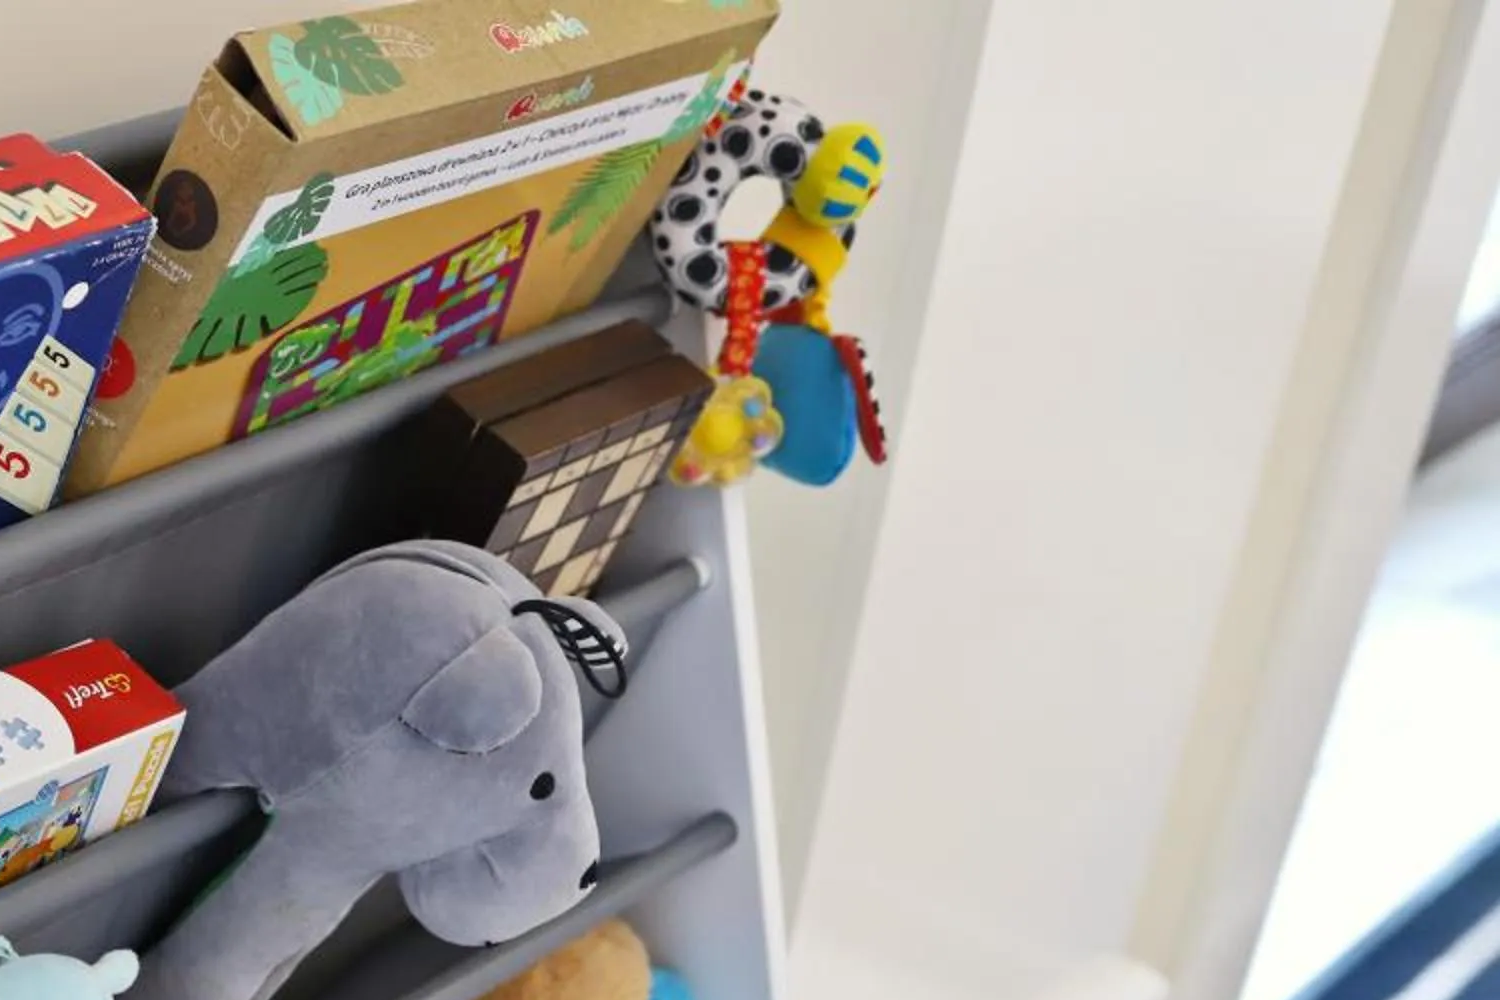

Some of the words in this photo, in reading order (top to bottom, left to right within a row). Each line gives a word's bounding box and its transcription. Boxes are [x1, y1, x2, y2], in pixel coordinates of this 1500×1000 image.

[45, 345, 71, 369] 5
[29, 372, 60, 398] 5
[13, 403, 47, 433] 5
[62, 681, 115, 709] Trefl
